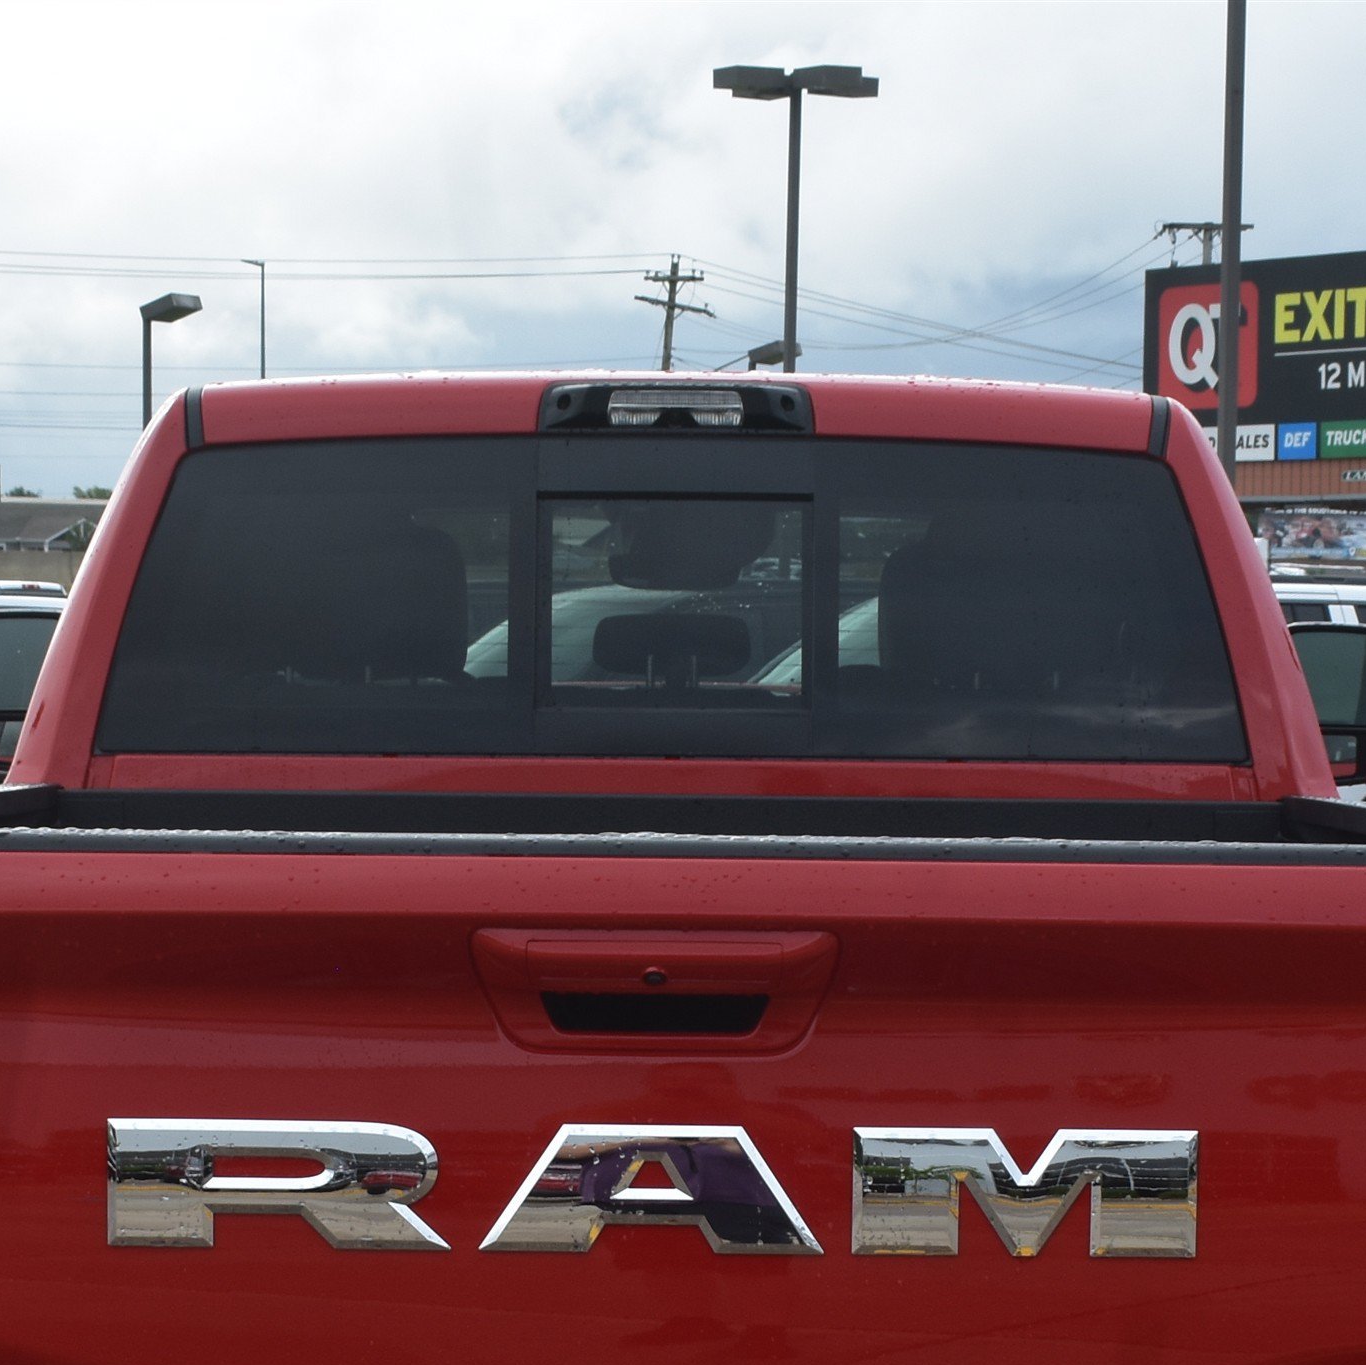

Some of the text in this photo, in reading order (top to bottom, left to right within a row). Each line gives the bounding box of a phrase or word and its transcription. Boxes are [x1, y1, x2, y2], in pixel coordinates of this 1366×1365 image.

[1318, 362, 1341, 390] 12
[1235, 429, 1270, 449] ALES
[1284, 431, 1312, 448] DEF
[105, 1116, 1200, 1259] RAM
